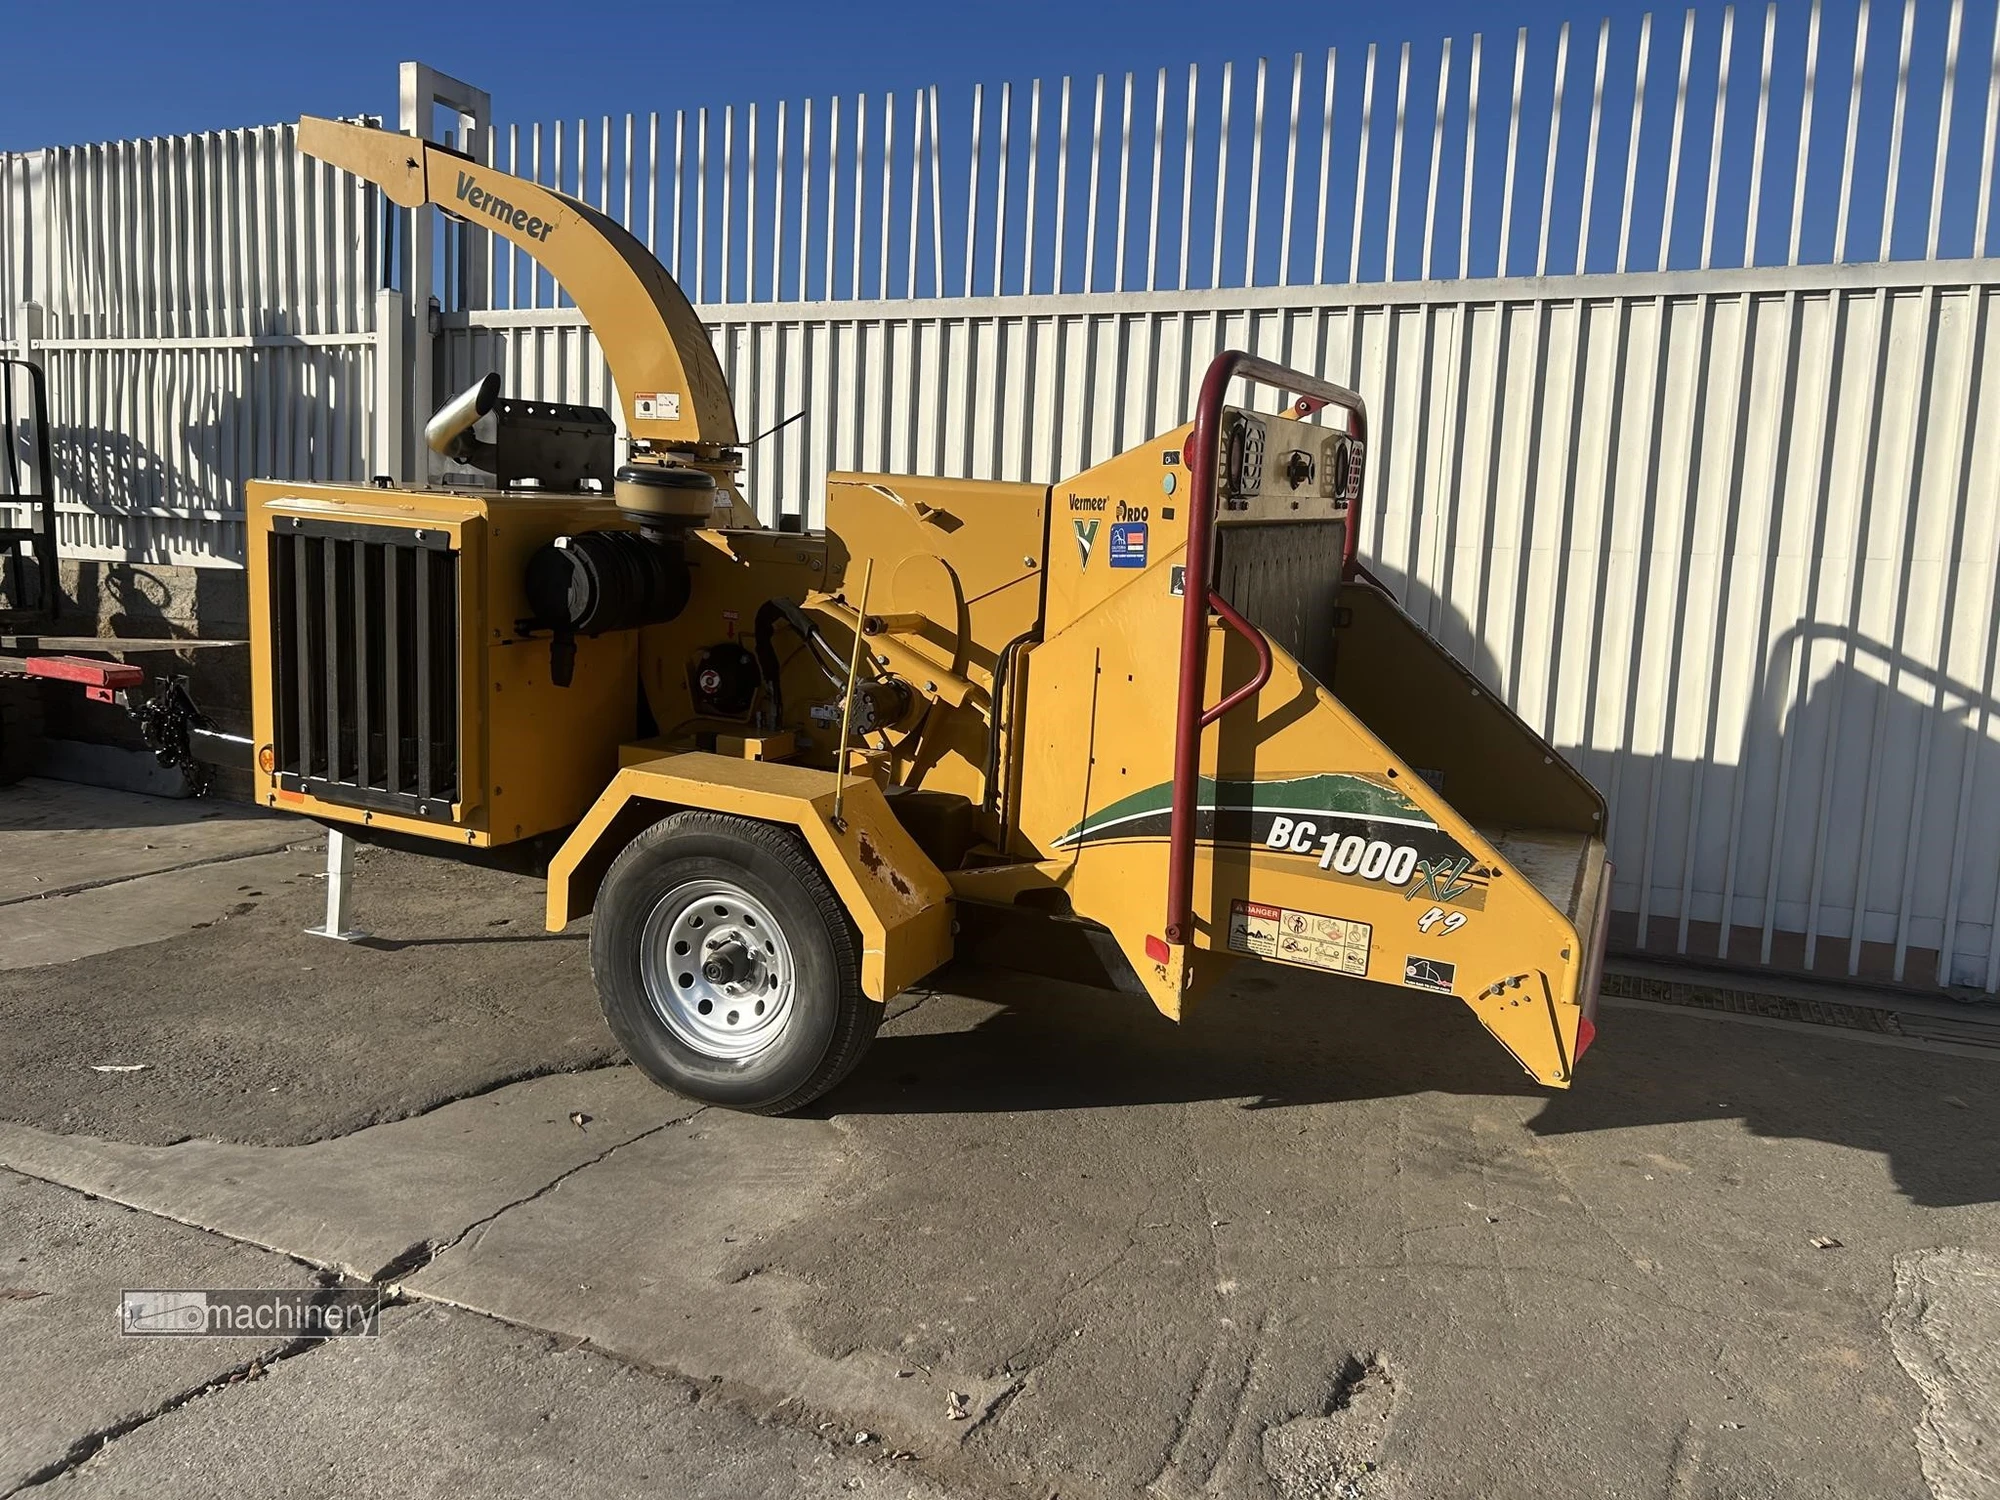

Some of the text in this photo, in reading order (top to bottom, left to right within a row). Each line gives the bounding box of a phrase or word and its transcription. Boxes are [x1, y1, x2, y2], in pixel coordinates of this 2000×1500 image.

[456, 170, 553, 242] Vermeer
[1069, 493, 1107, 511] Vermeer
[1265, 815, 1474, 902] BC 1000 XL
[1245, 905, 1279, 918] DANGER
[1417, 905, 1469, 937] 49
